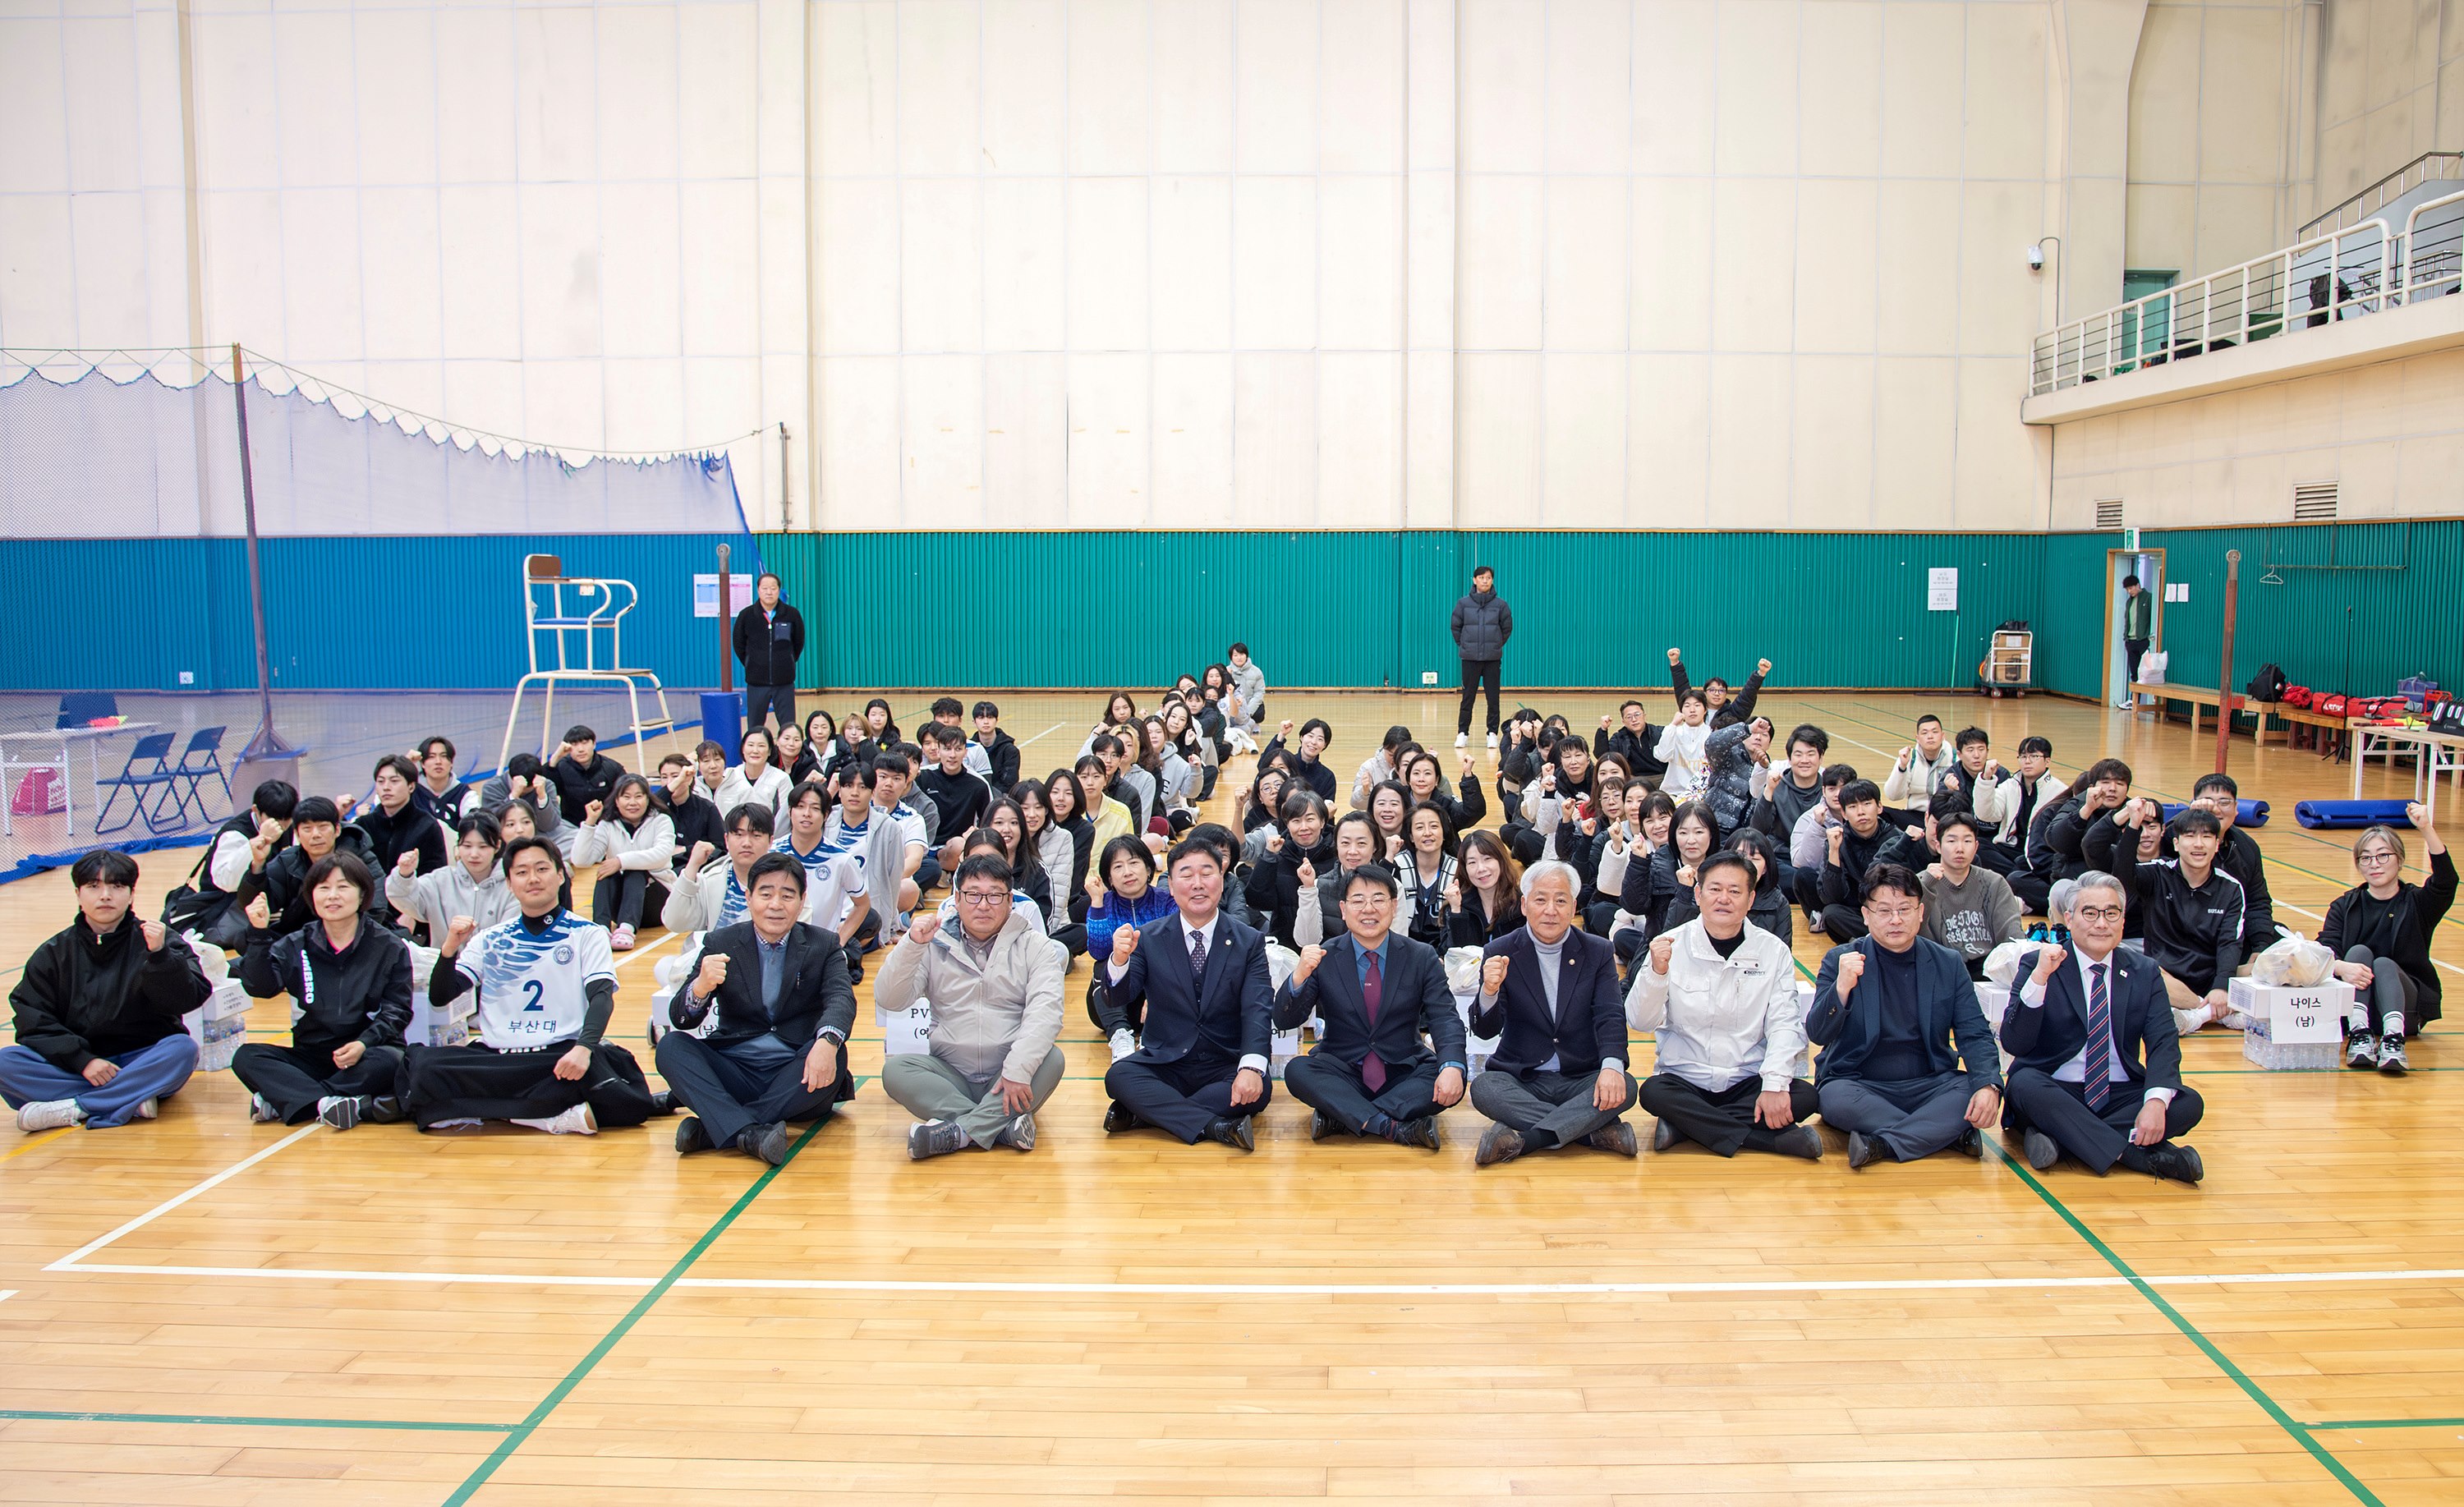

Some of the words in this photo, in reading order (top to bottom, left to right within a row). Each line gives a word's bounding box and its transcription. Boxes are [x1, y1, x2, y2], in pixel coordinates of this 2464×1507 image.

[522, 980, 544, 1011] 2
[2290, 997, 2321, 1008] 나이스
[911, 1008, 930, 1018] PV
[508, 1020, 557, 1033] 부산대
[2296, 1016, 2315, 1027] (남)
[914, 1027, 930, 1039] (여
